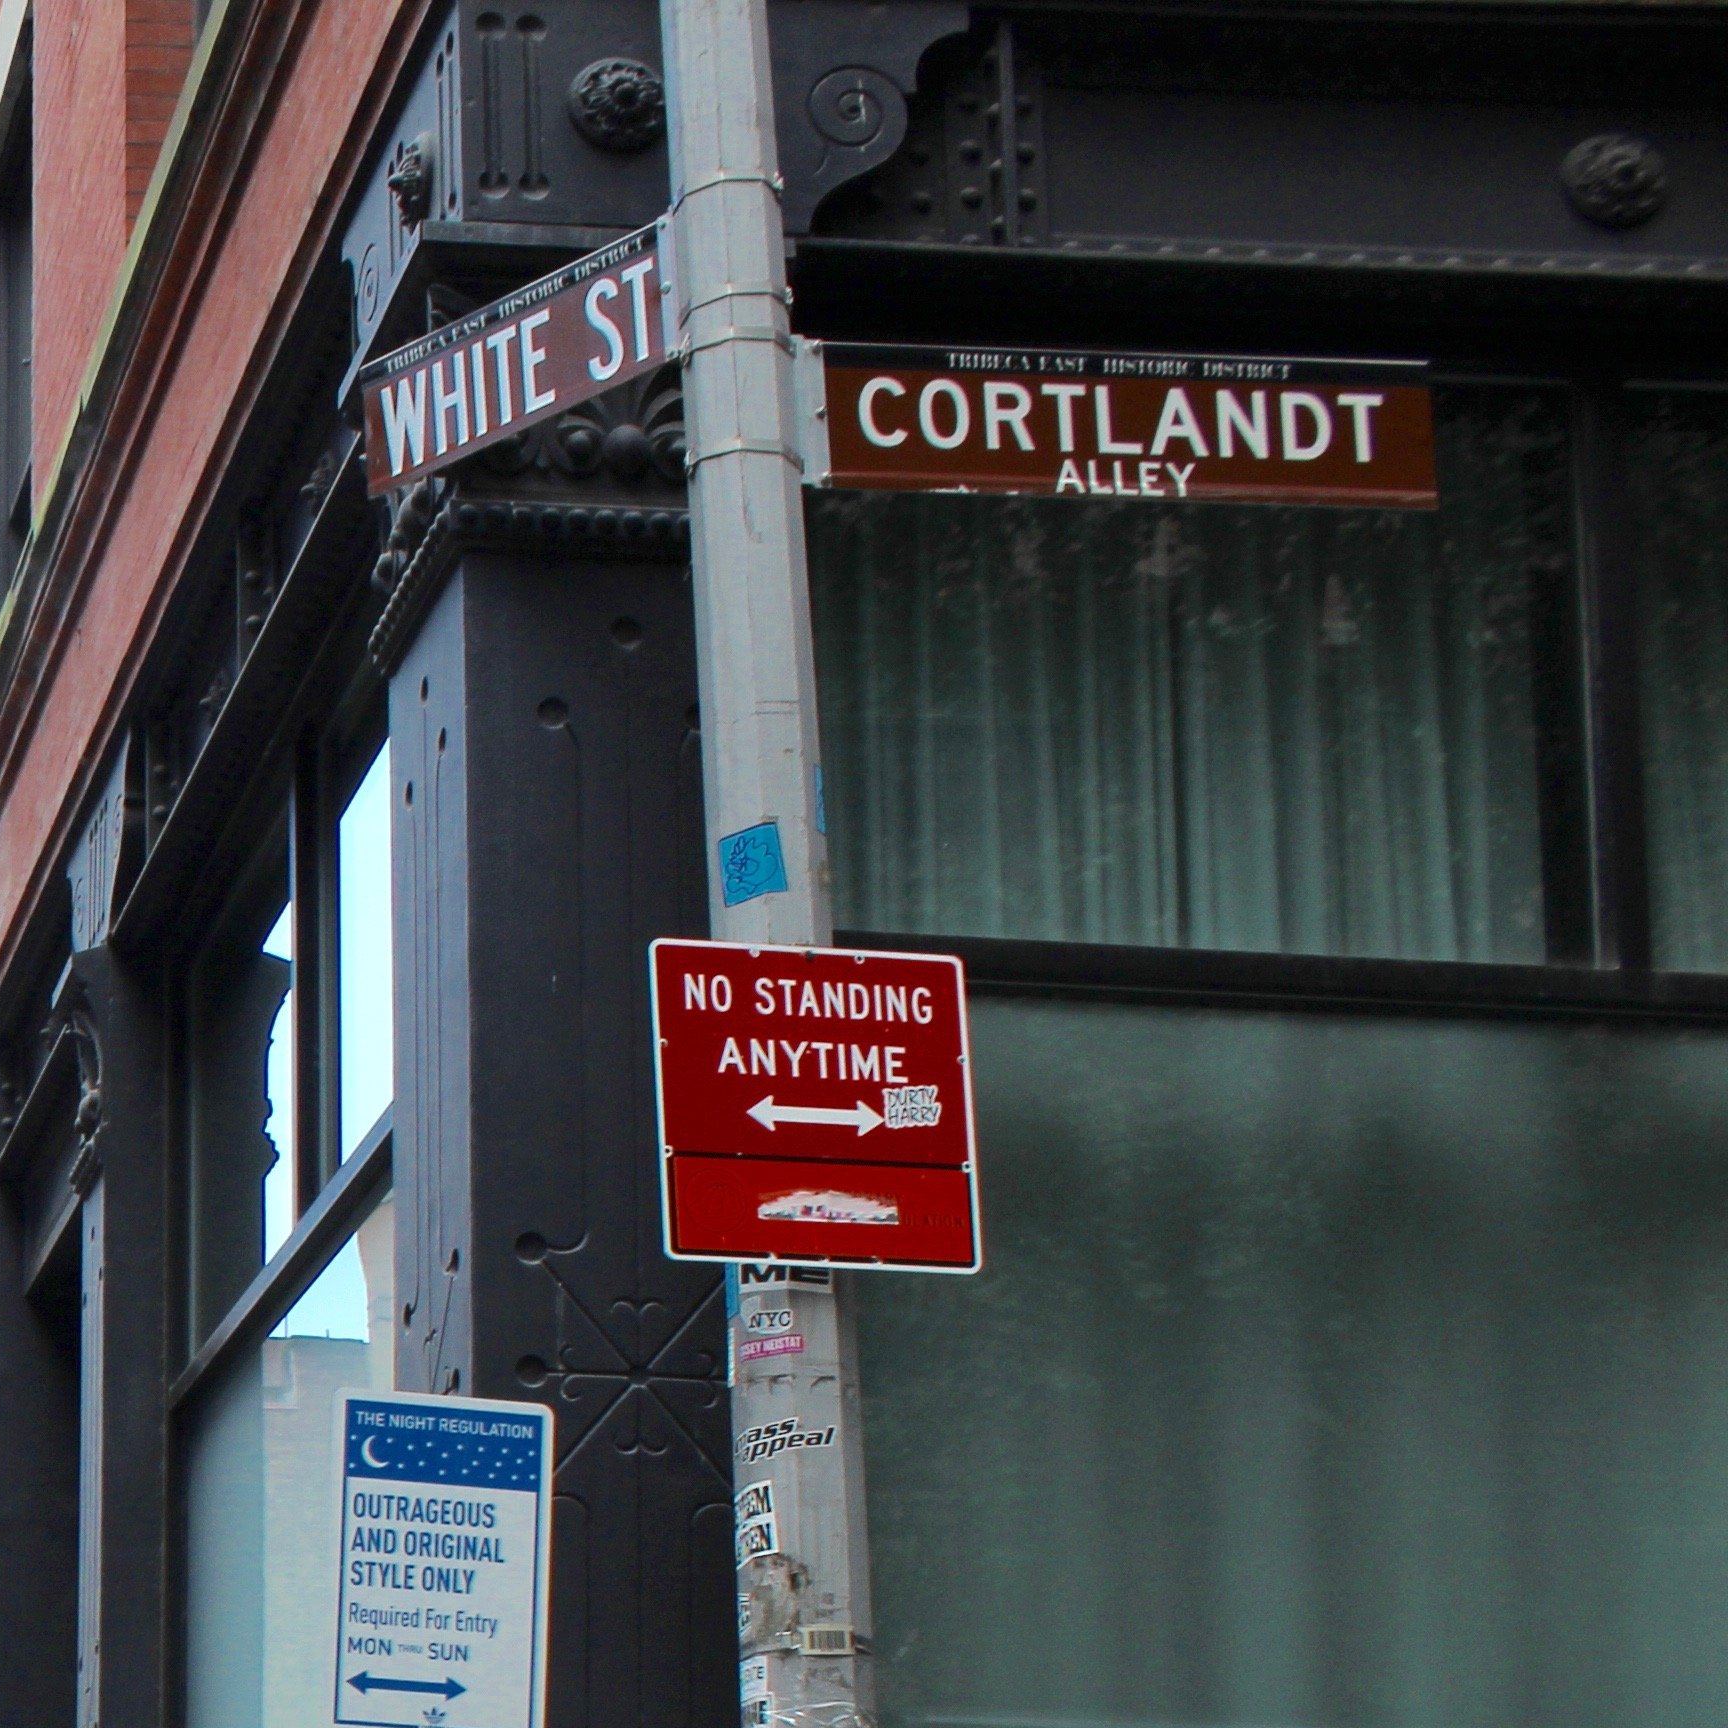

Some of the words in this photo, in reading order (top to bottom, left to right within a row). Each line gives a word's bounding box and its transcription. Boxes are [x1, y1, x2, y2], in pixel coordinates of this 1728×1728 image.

[384, 332, 449, 373] TRIBECA
[452, 312, 489, 341] EAST
[497, 275, 569, 320] HISTORIC
[574, 235, 645, 282] DISTRICT
[380, 308, 556, 478] WHITE
[584, 256, 654, 382] ST
[947, 352, 1029, 371] TRIBECA
[1038, 355, 1088, 374] EAST
[1102, 358, 1194, 376] HISTORIC
[1202, 360, 1292, 381] DISTRICT
[857, 376, 1383, 462] CORTLANDT
[1056, 459, 1195, 497] ALLEY
[684, 973, 732, 1012] NO
[755, 978, 933, 1024] STANDING
[718, 1038, 909, 1084] ANYTIME
[888, 1088, 935, 1109] DURTY
[888, 1105, 938, 1126] HARRY
[749, 1311, 791, 1328] NYC
[356, 1411, 386, 1427] THE
[389, 1414, 435, 1432] NIGHT
[439, 1419, 533, 1438] REGULATION
[353, 1492, 495, 1528] OUTRAGEOUS
[351, 1528, 396, 1555] AND
[404, 1531, 504, 1563] ORIGINAL
[351, 1561, 414, 1590] STYLE
[422, 1566, 475, 1595] ONLY
[348, 1603, 419, 1629] Required
[426, 1608, 450, 1629] For
[456, 1610, 498, 1639] Entry
[347, 1638, 391, 1656] MON
[428, 1643, 469, 1661] SUN
